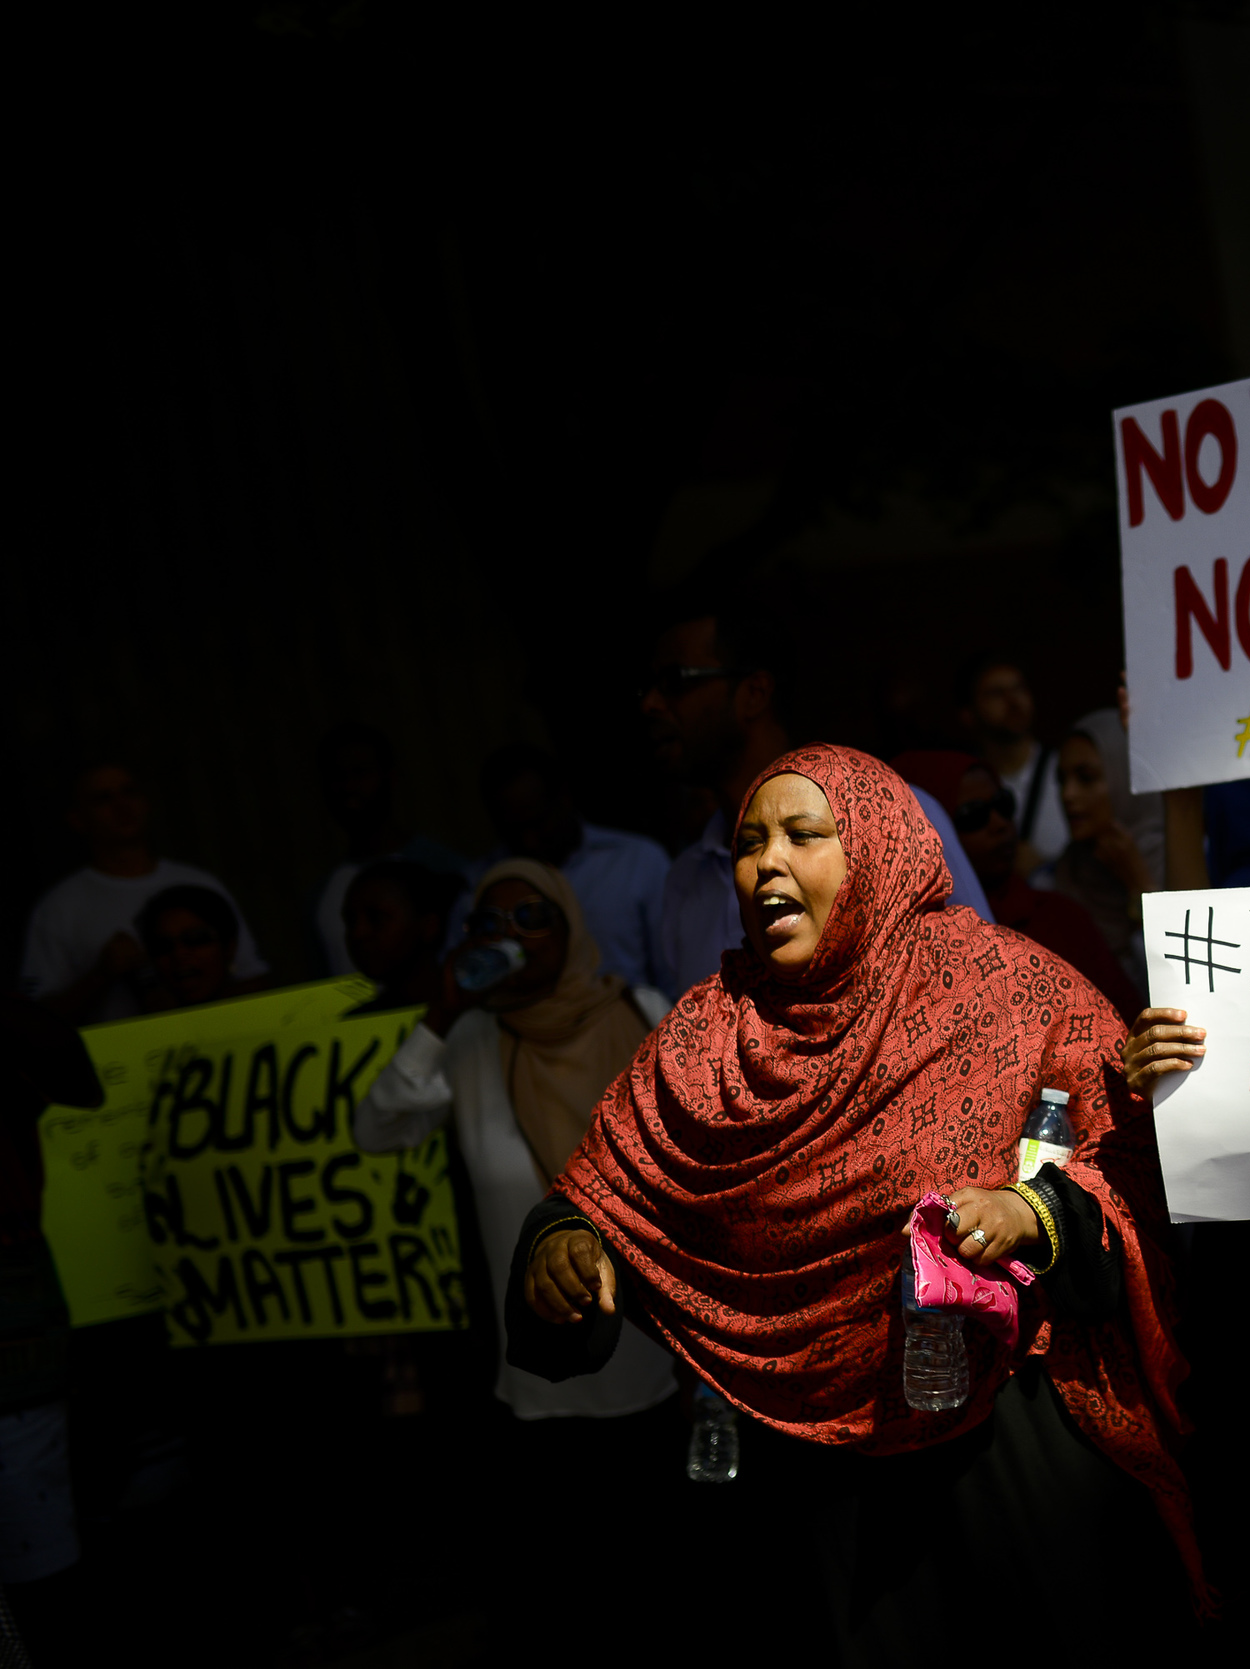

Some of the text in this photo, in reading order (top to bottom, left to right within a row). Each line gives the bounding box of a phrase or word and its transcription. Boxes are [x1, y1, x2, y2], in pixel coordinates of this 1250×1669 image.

[1121, 399, 1237, 528] NO
[169, 1036, 380, 1158] BLACK
[167, 1153, 373, 1249] LIVES
